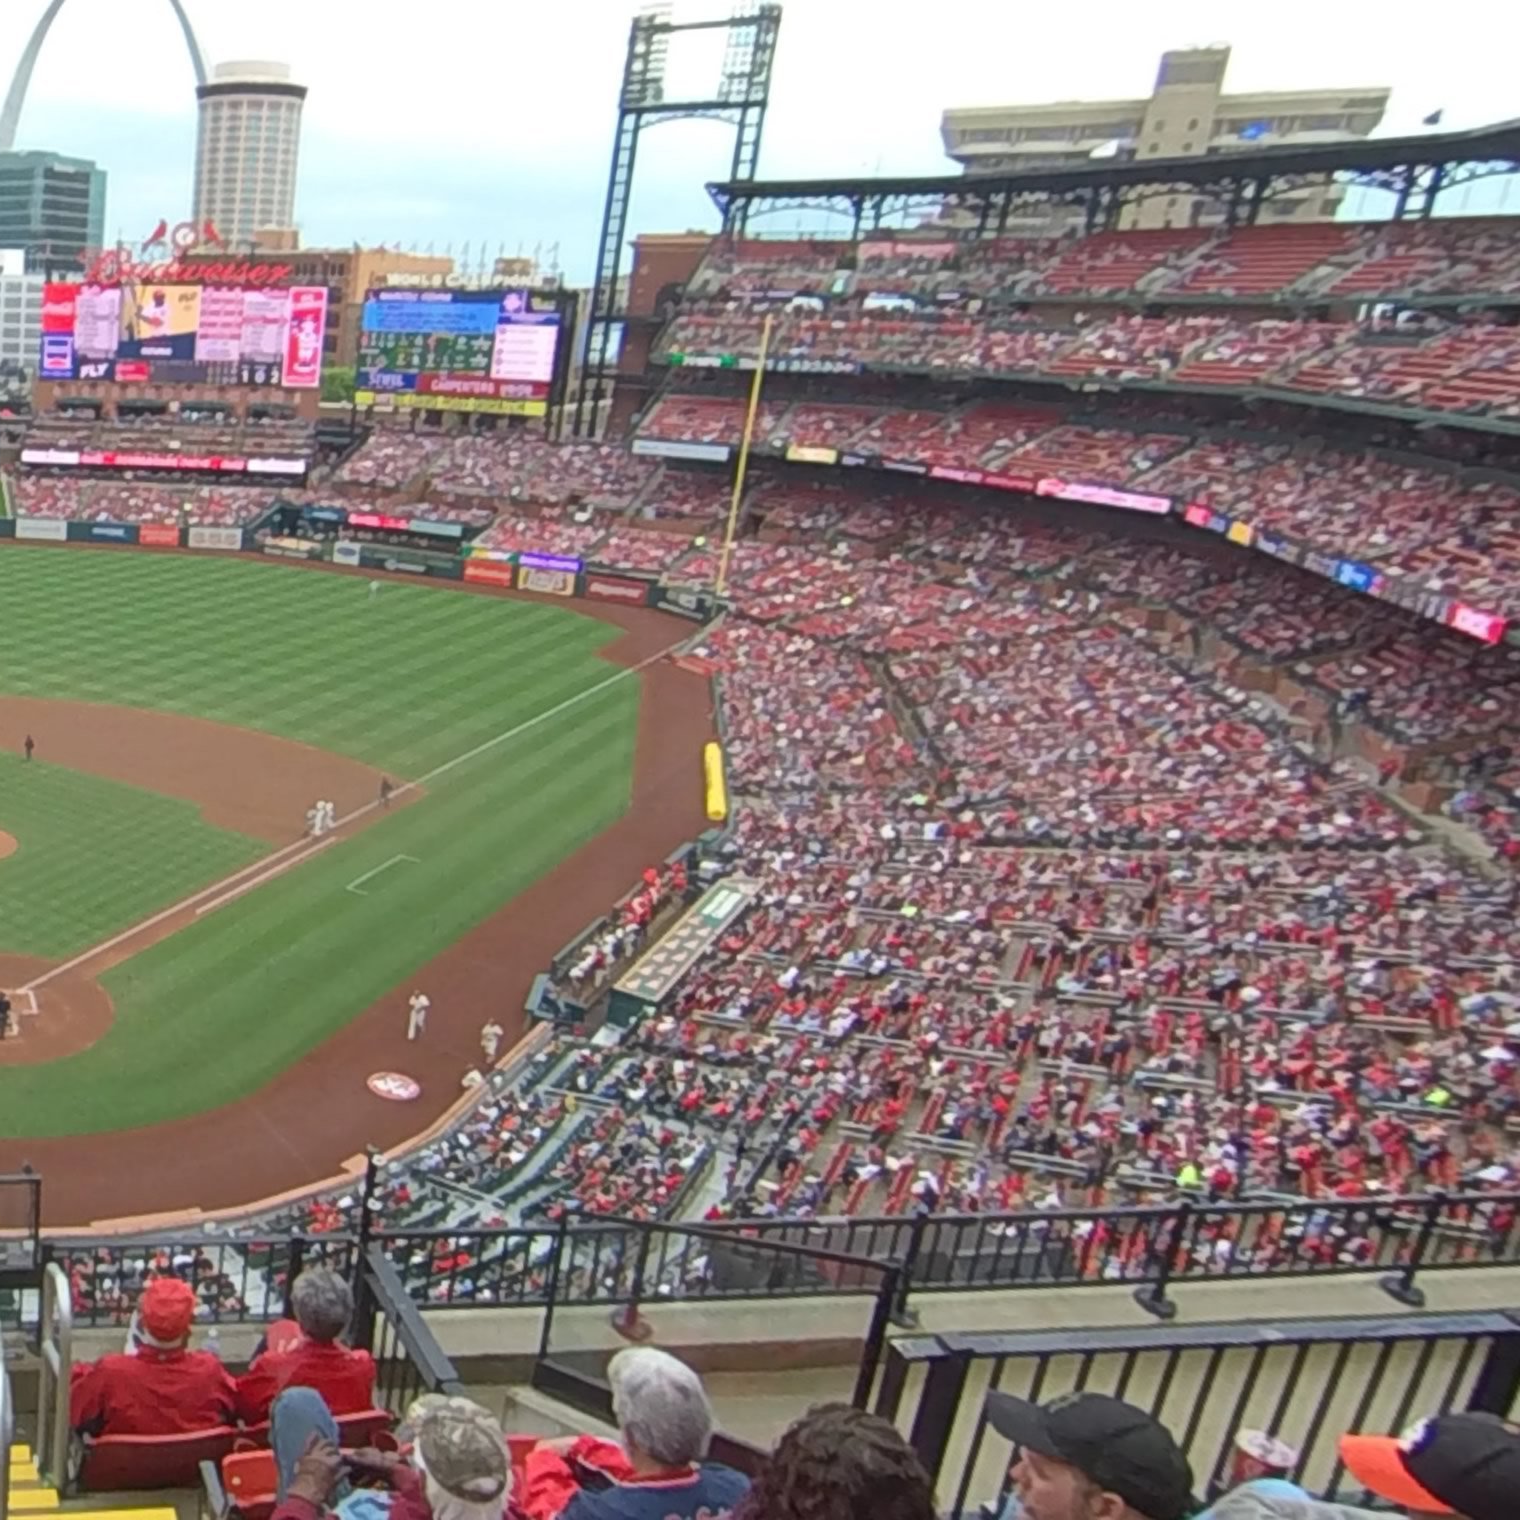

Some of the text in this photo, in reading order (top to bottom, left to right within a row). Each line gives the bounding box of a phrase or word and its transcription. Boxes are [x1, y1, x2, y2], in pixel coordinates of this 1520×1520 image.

[86, 246, 292, 284] Budweiser
[386, 272, 442, 287] WORLD
[80, 362, 109, 379] FLY
